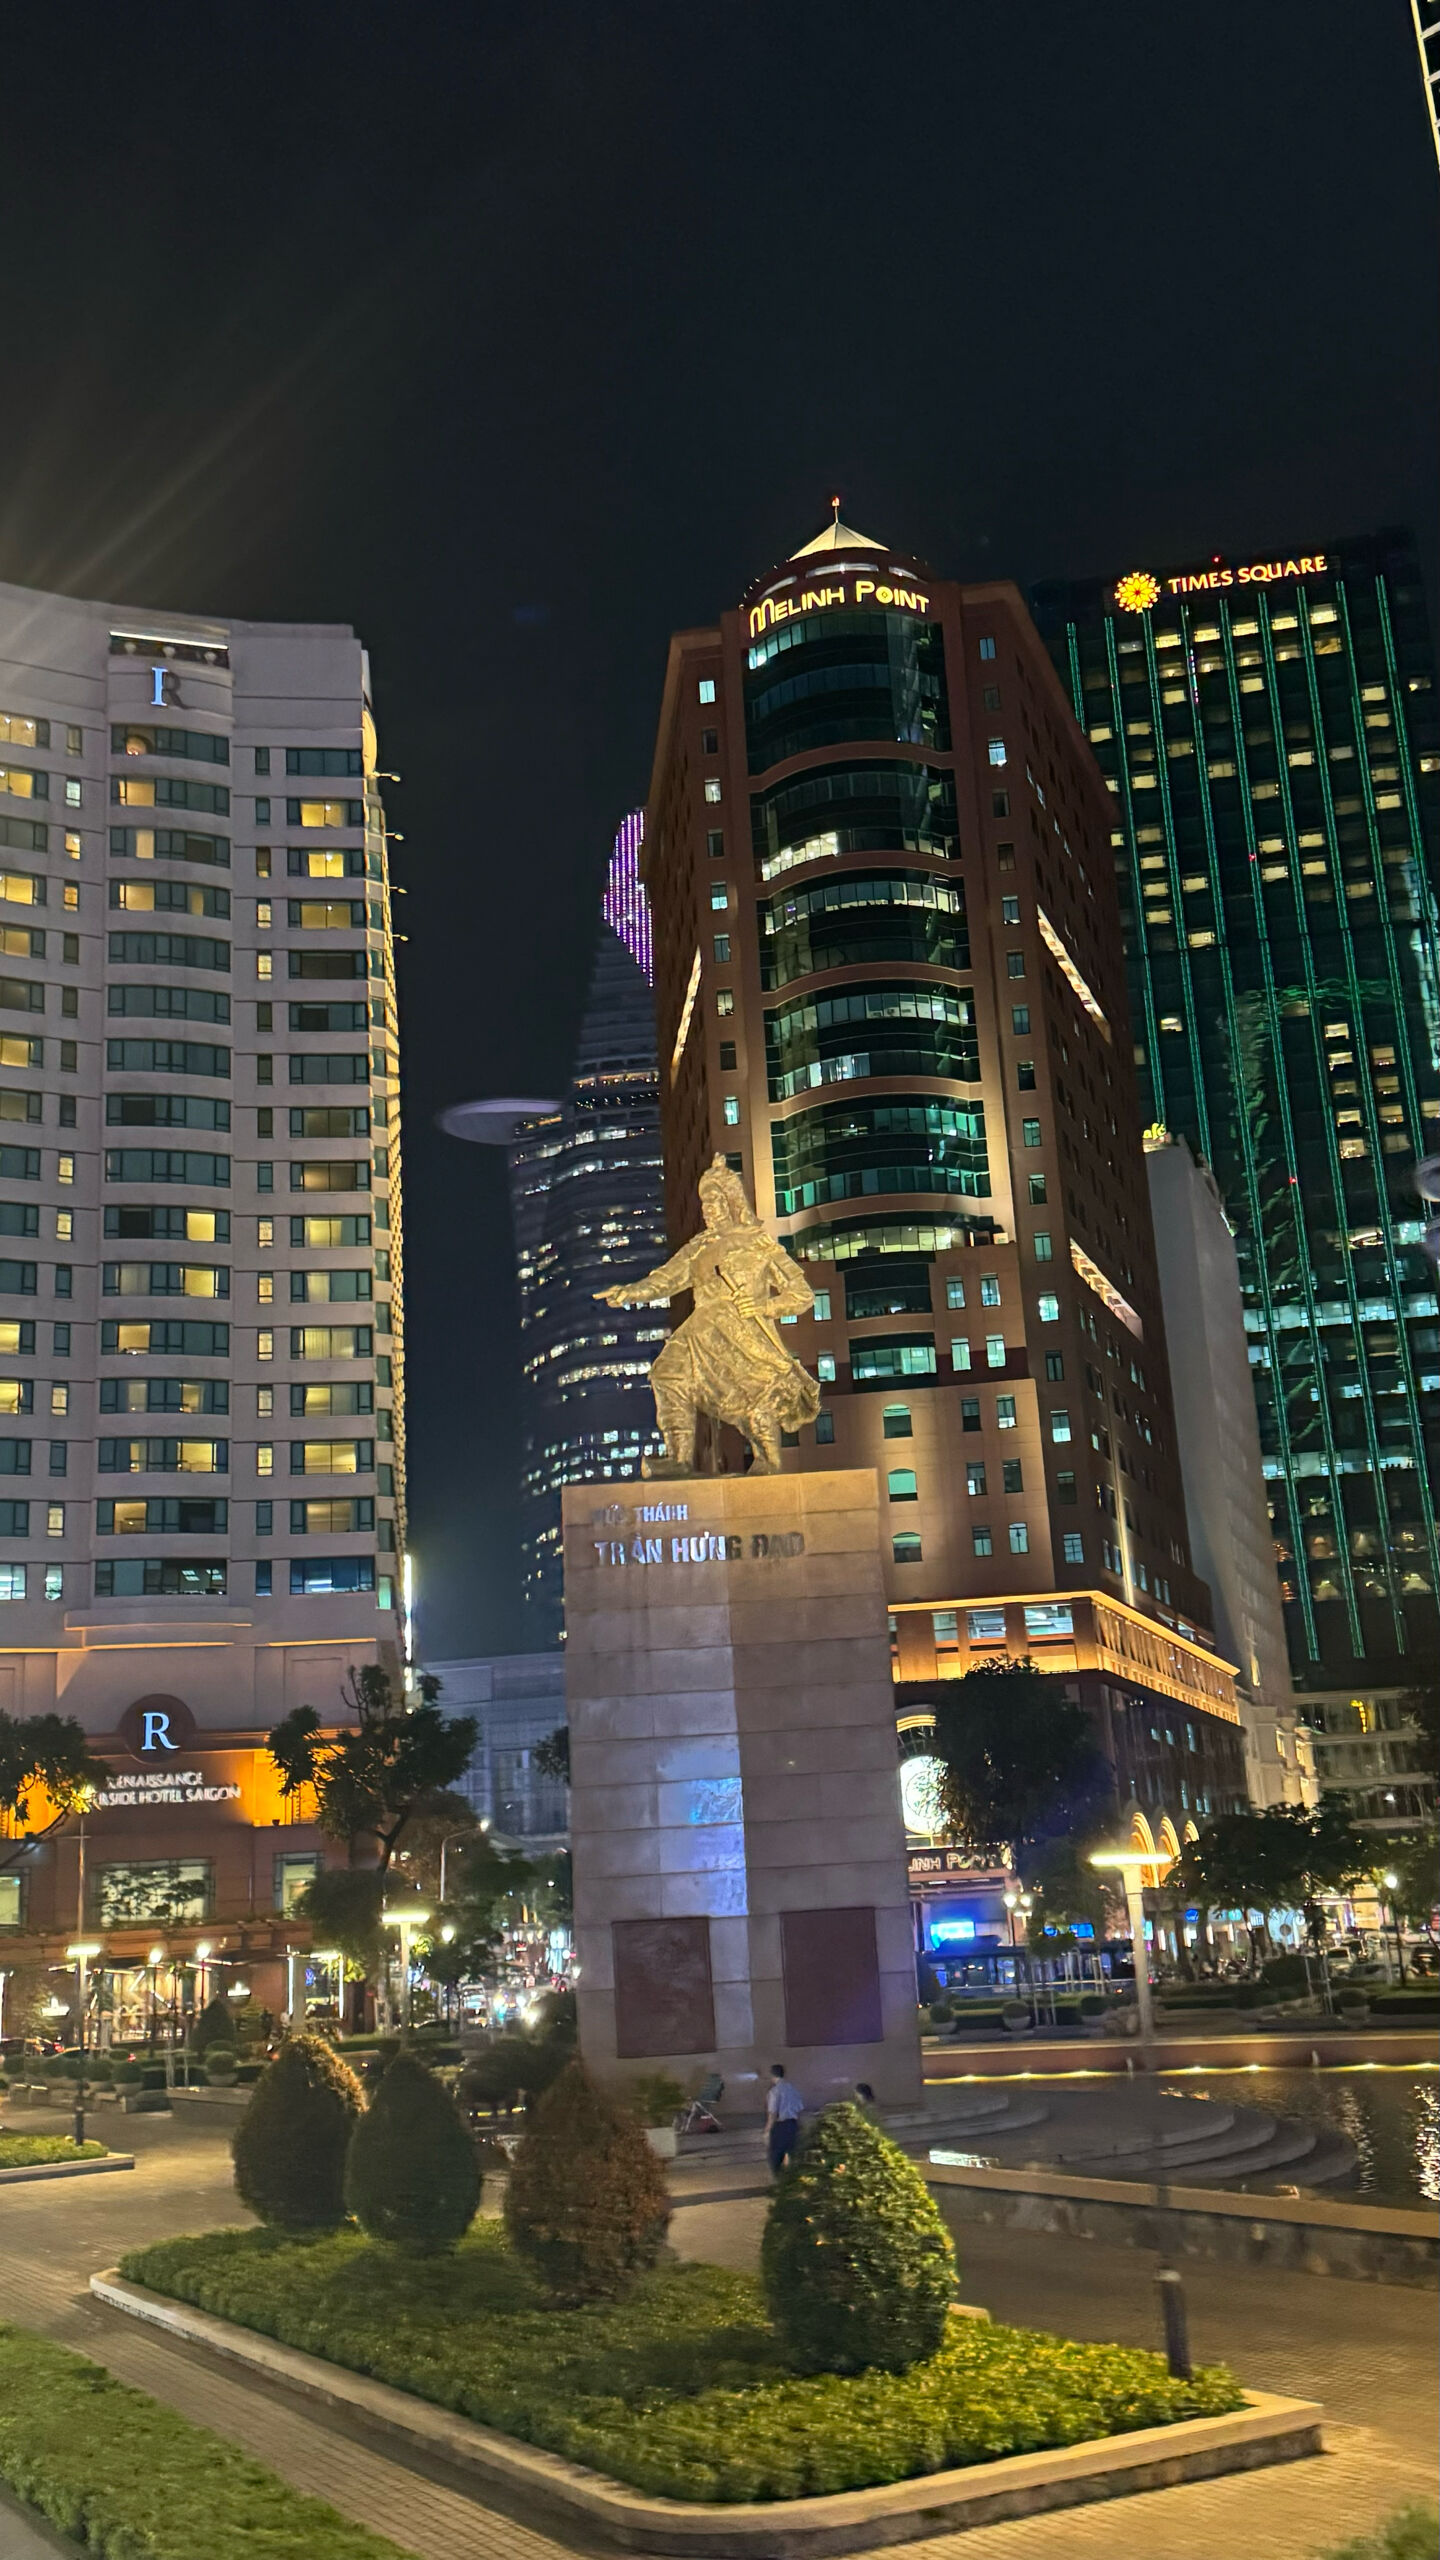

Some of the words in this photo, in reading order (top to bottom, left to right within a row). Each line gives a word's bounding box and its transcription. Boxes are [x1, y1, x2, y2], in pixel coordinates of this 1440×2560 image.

[1168, 570, 1234, 594] TIMES
[1237, 556, 1328, 582] SQUARE
[750, 586, 845, 639] MELINH
[855, 580, 930, 613] POINT
[671, 1531, 742, 1563] HƯNG
[141, 1711, 181, 1750] R
[138, 1787, 184, 1804] HOTEL
[185, 1784, 241, 1802] SAIGON
